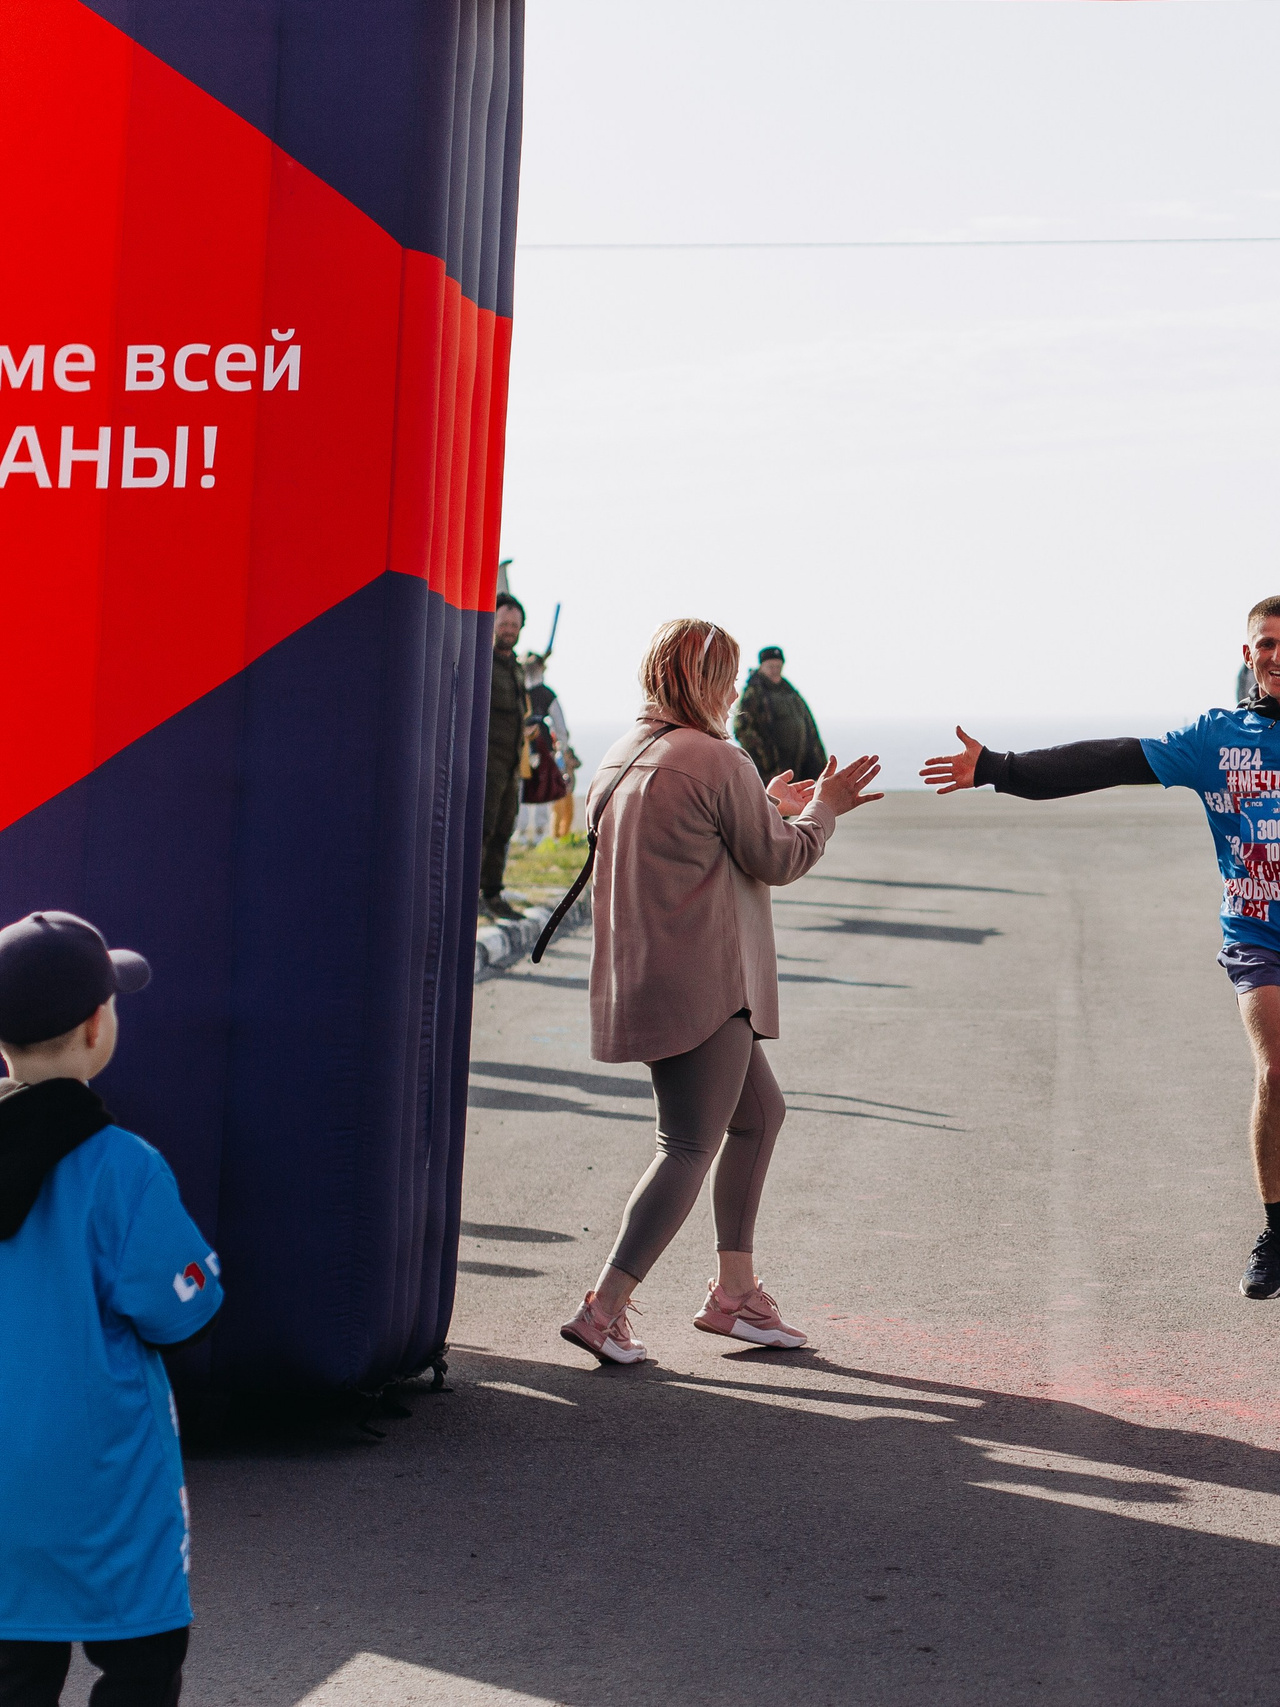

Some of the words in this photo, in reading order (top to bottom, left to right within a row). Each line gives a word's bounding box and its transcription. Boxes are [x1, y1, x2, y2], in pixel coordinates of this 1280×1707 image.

[125, 328, 302, 392] всей
[0, 425, 219, 489] АНЫ!
[1219, 747, 1264, 770] 2024
